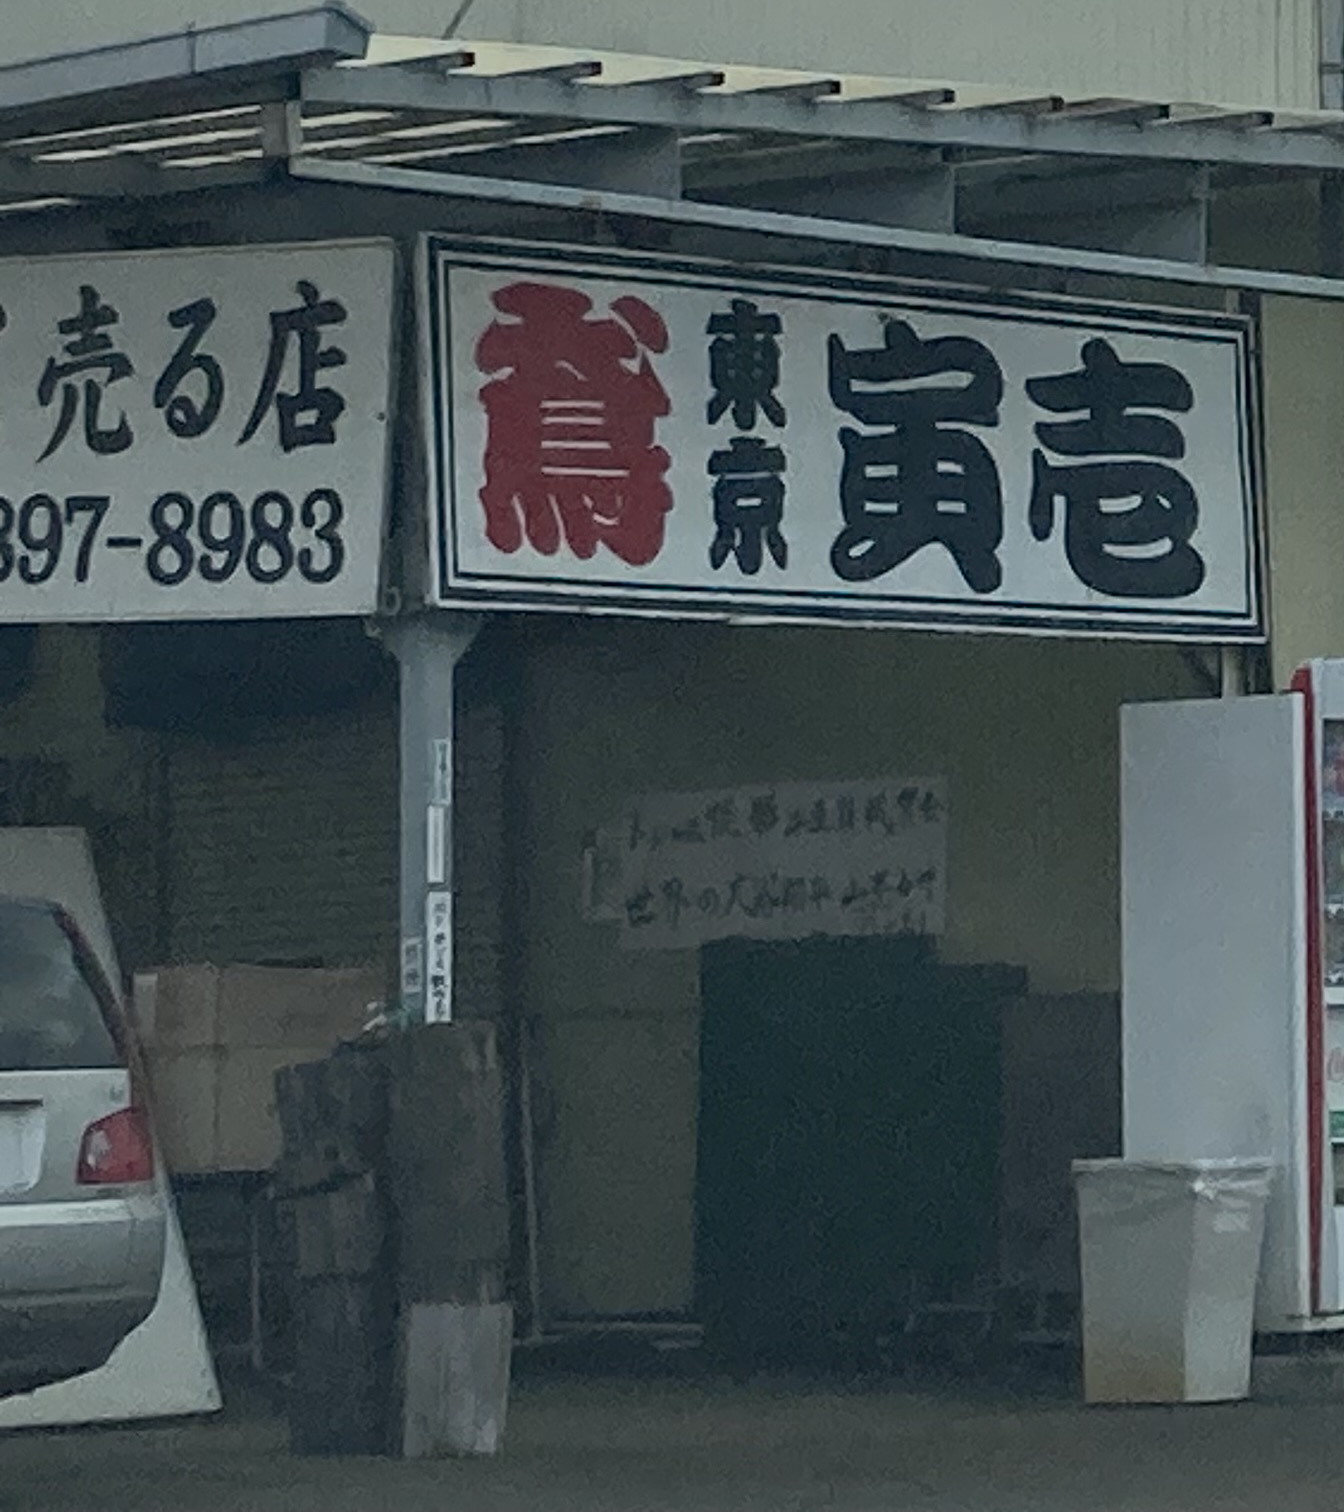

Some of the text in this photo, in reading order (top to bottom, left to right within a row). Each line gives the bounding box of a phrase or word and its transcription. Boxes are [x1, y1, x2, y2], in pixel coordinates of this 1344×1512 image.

[0, 280, 348, 464] 売る店
[705, 298, 790, 576] 東京
